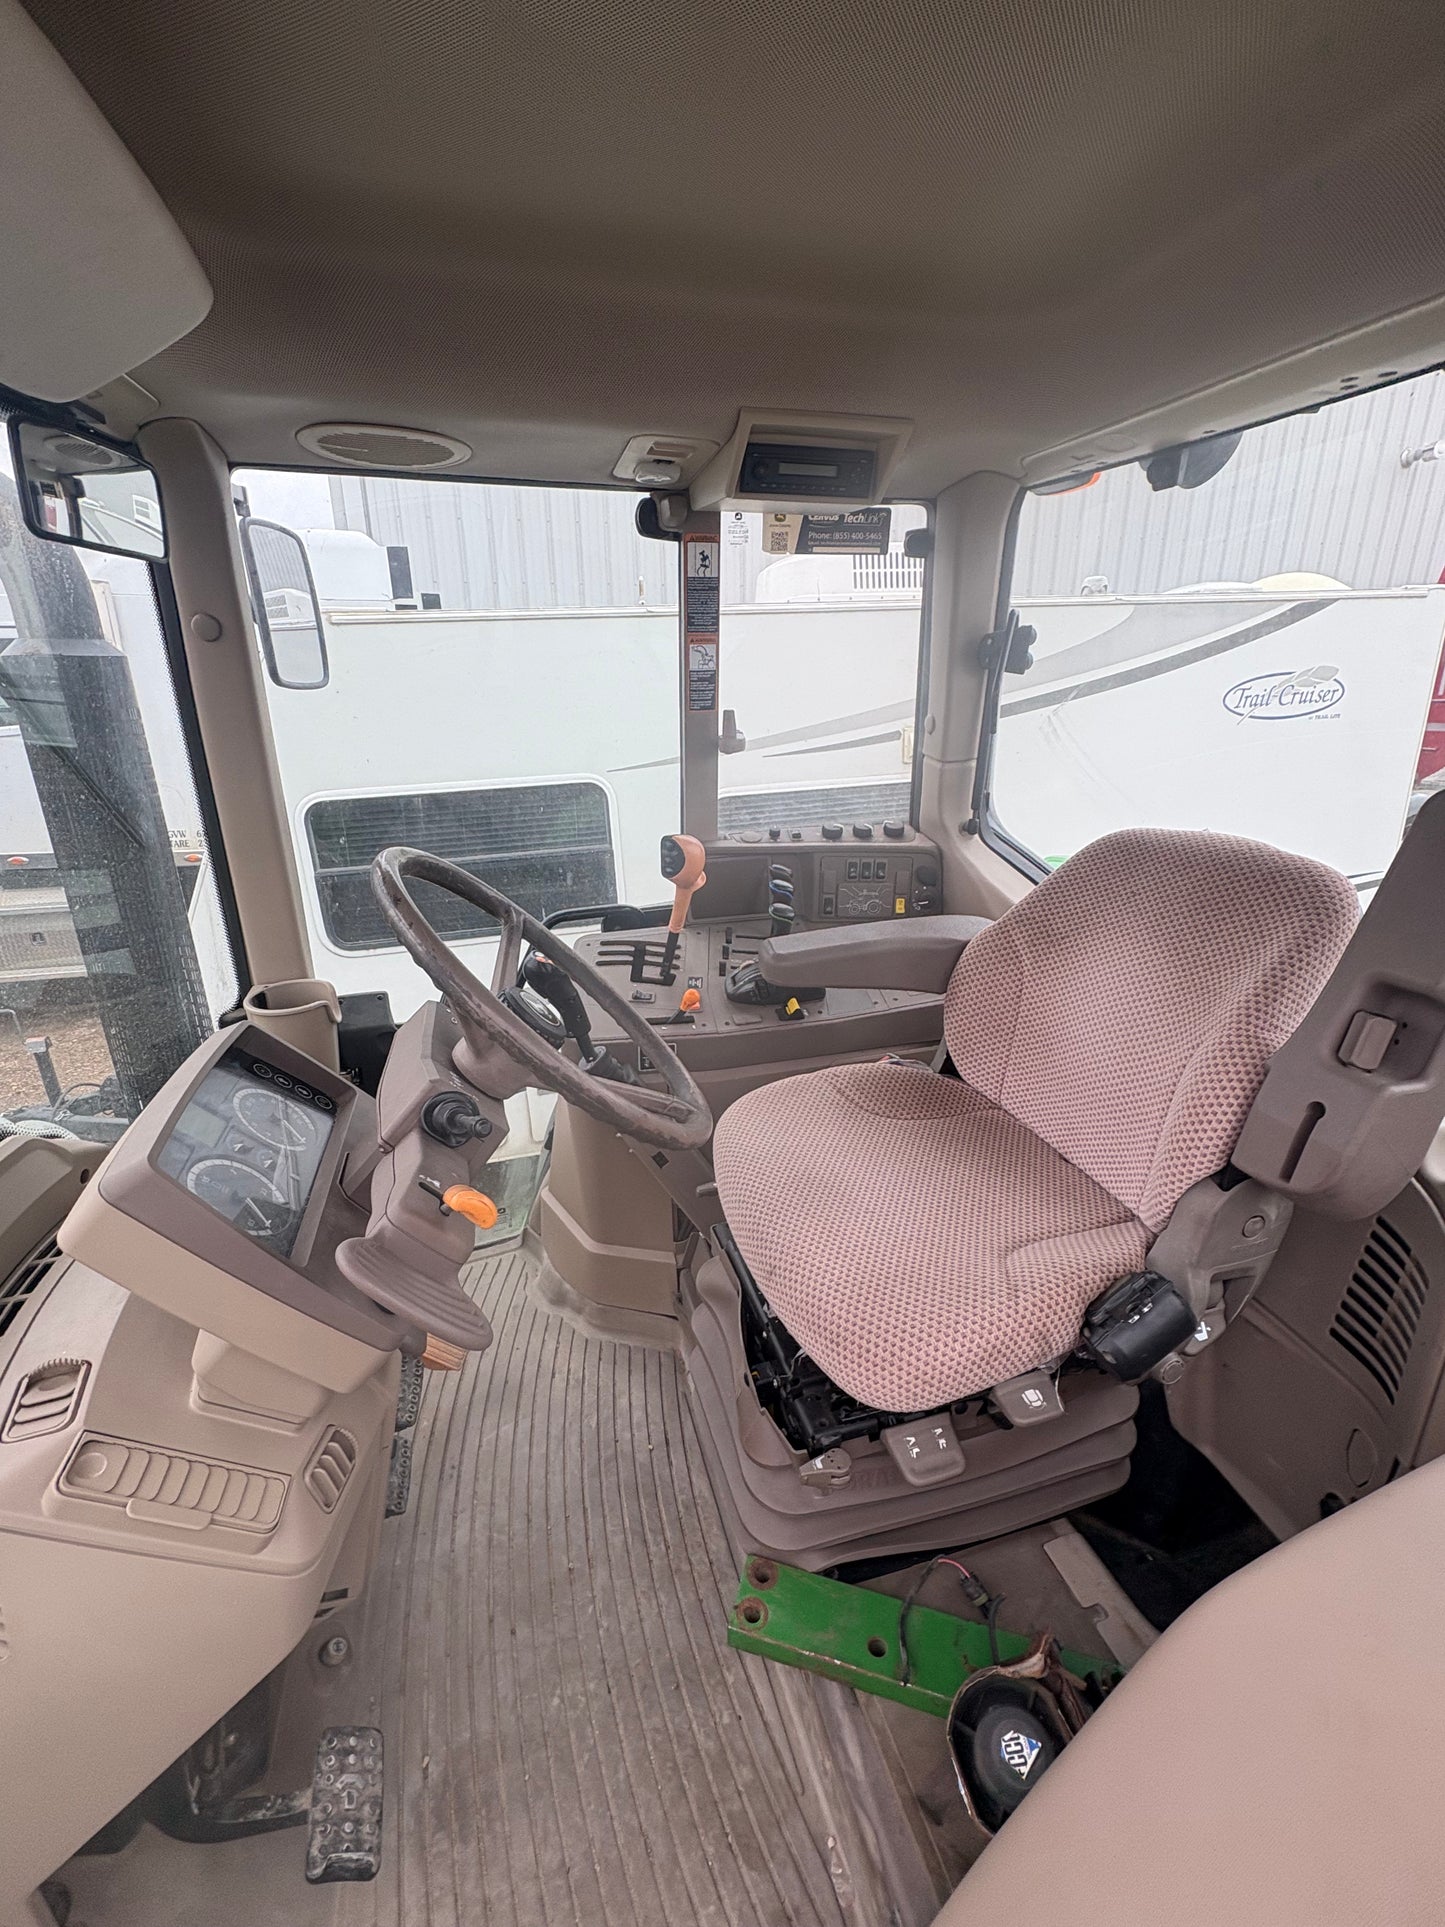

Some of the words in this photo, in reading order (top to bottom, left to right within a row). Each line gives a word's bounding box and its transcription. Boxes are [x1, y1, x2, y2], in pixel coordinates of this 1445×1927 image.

[843, 512, 879, 523] TechLink
[808, 531, 831, 540] Phone:
[833, 531, 850, 540] (855)
[851, 531, 882, 540] 400-5465
